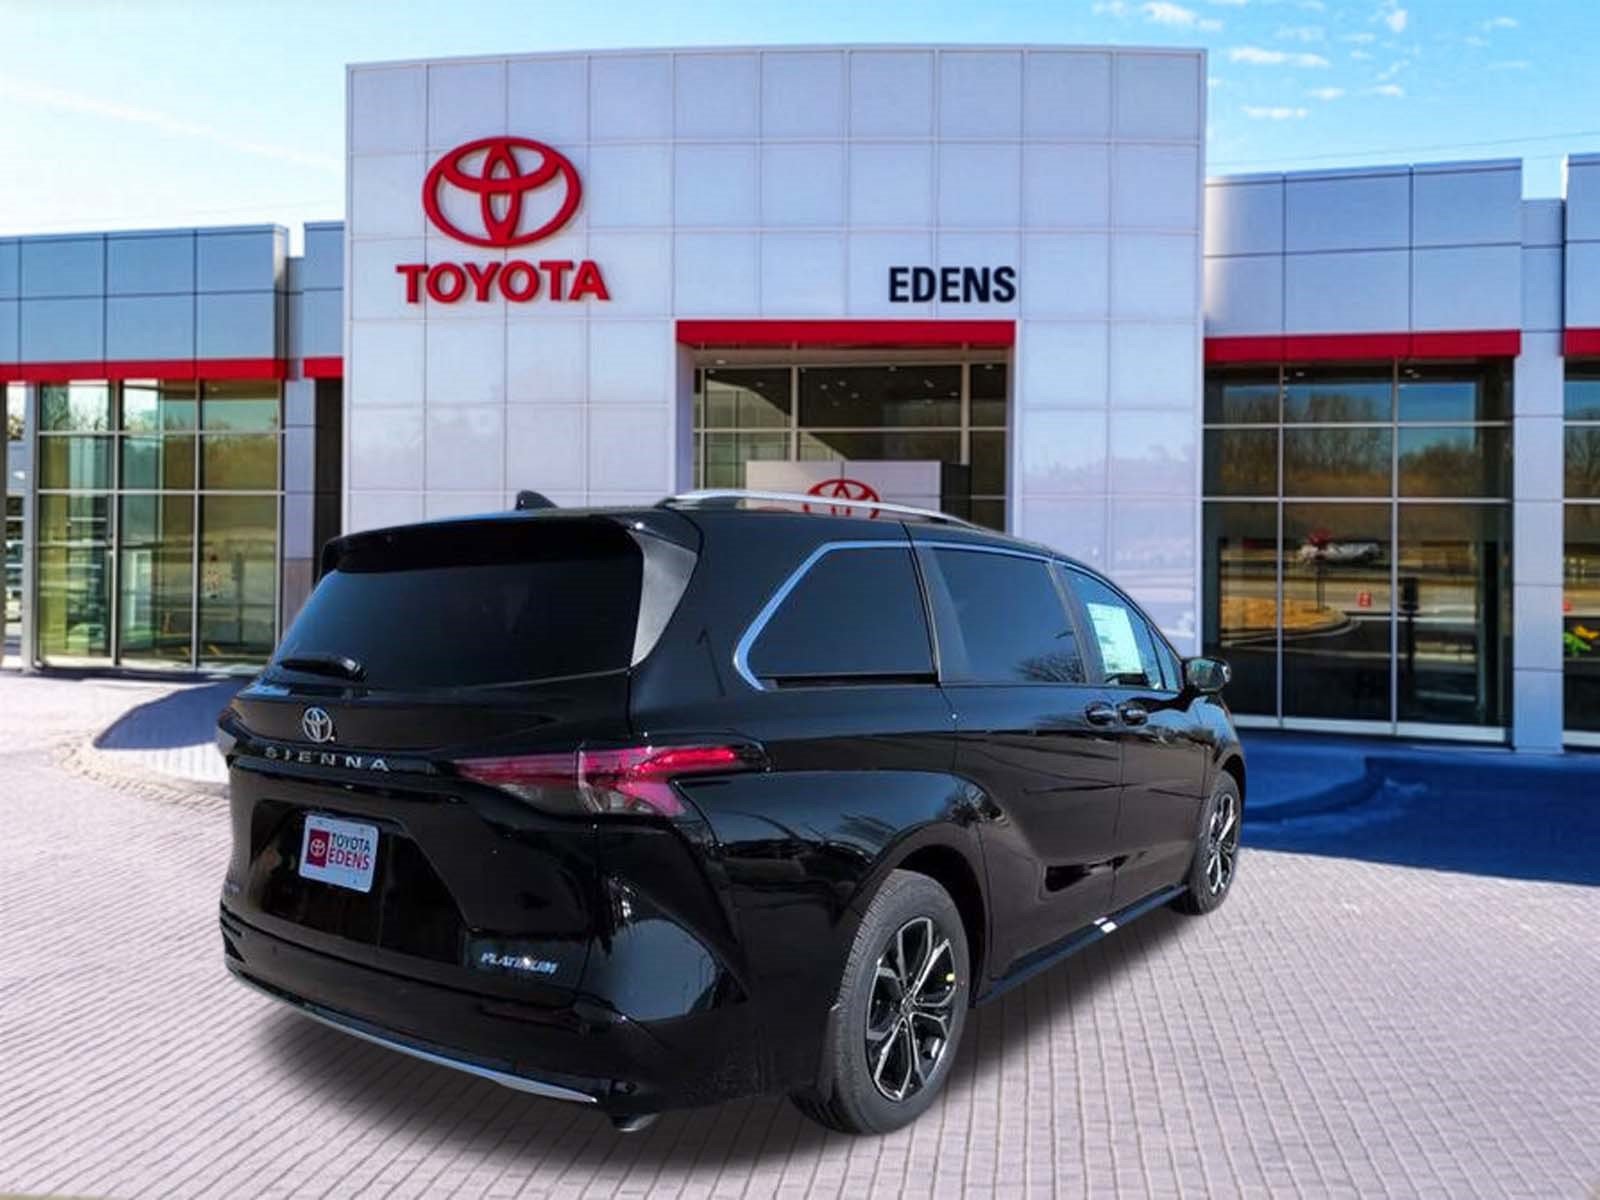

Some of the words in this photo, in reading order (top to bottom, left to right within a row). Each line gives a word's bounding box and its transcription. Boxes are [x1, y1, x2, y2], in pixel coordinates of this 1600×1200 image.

[396, 259, 611, 304] TOYOTA
[889, 266, 1016, 303] EDENS
[264, 746, 390, 772] SIENNA
[331, 832, 371, 852] TOYOTA
[328, 847, 370, 870] EDENS
